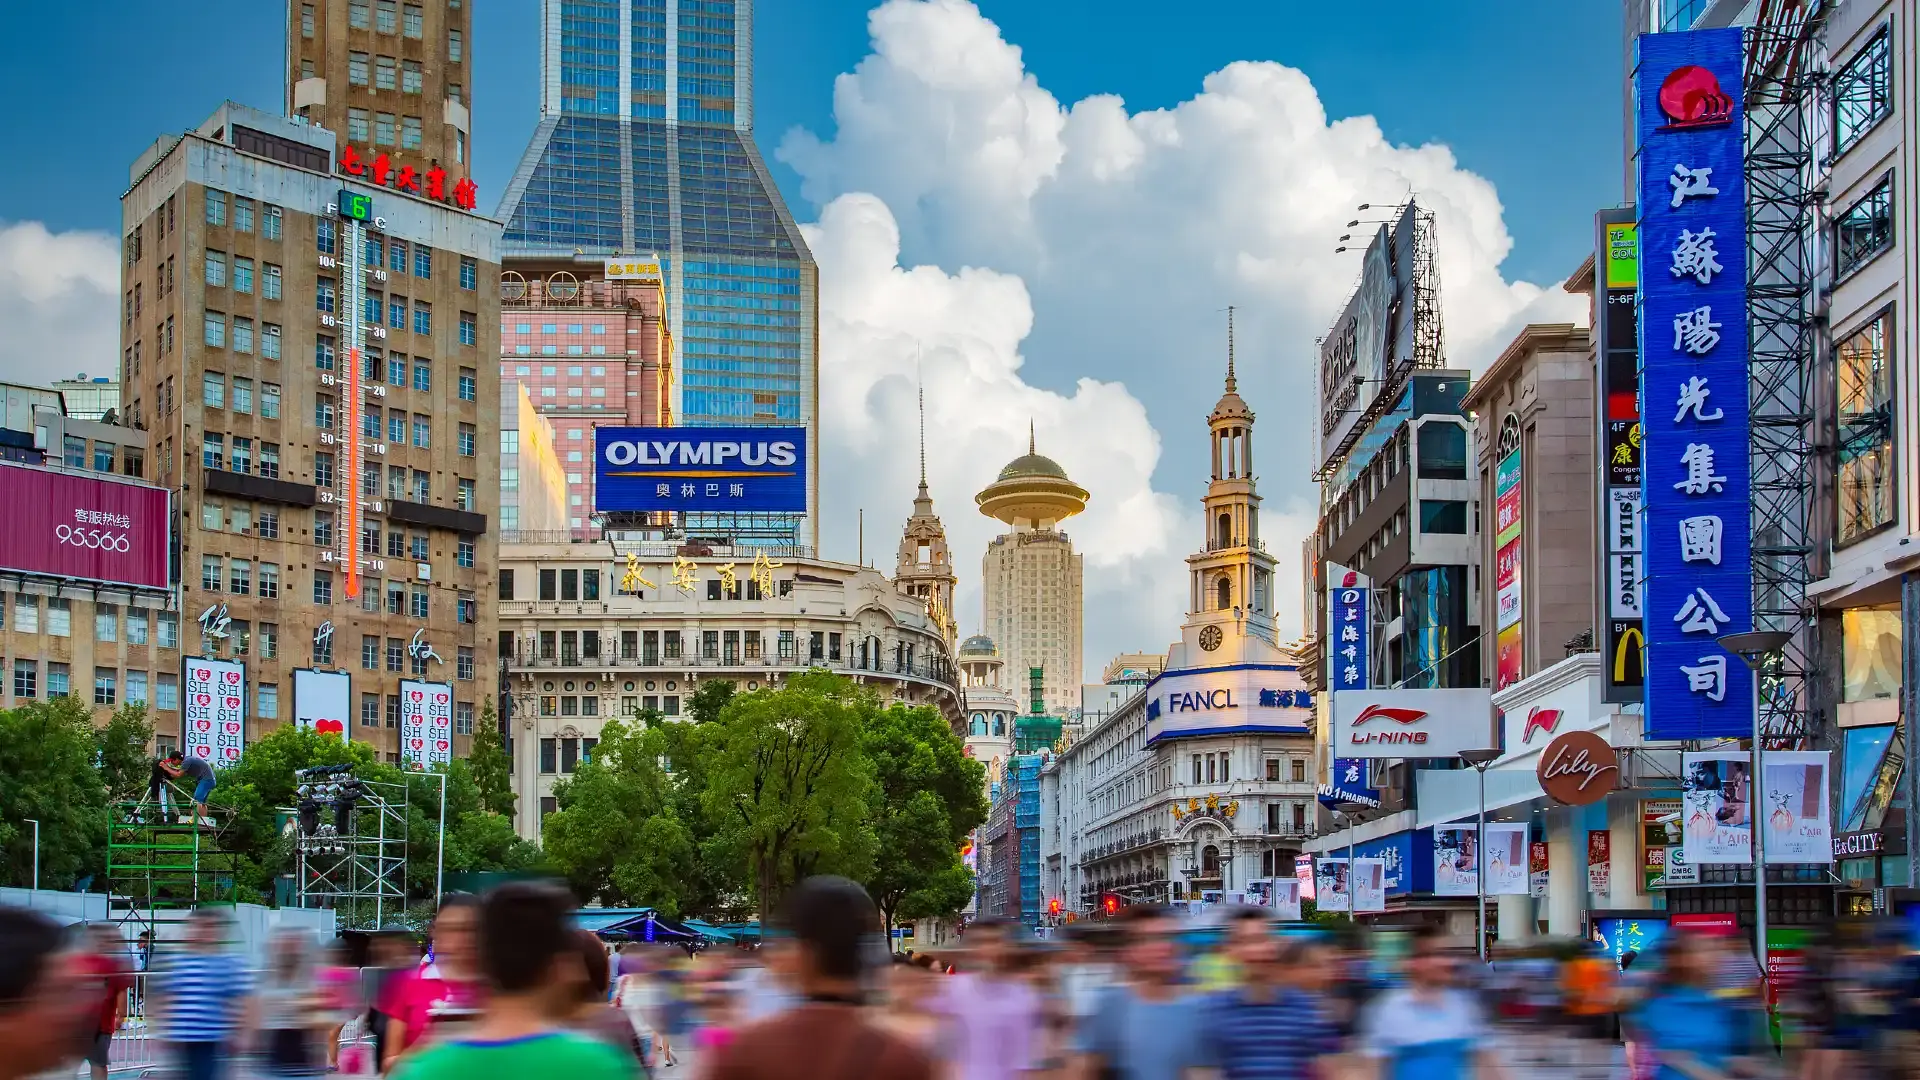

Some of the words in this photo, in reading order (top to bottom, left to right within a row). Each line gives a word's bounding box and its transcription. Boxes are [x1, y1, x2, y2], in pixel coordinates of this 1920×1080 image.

[327, 203, 337, 214] F
[1610, 231, 1624, 240] 7F
[319, 256, 335, 268] 104
[374, 270, 387, 281] 40
[1608, 295, 1634, 304] 5-6F
[322, 315, 335, 327] 86
[374, 328, 386, 339] 30
[321, 374, 334, 385] 68
[374, 386, 386, 397] 20
[1611, 423, 1626, 432] 4F
[1669, 163, 1731, 701] 江蘇陽光集團公司
[321, 433, 334, 444] 50
[374, 443, 385, 454] 10
[605, 441, 797, 466] OLYMPUS
[656, 483, 744, 498] 奥林巴斯
[321, 492, 334, 503] 32
[74, 508, 131, 529] 客服热线
[1619, 502, 1633, 549] SILK
[56, 524, 130, 552] 95566
[321, 551, 333, 562] 14
[1620, 555, 1634, 607] KING
[1615, 623, 1627, 632] B1
[1169, 689, 1239, 713] FANCL
[1351, 732, 1429, 744] LI-NING
[1544, 744, 1618, 791] Lily
[1317, 784, 1341, 799] NO.1
[1340, 790, 1382, 809] PHARMACY
